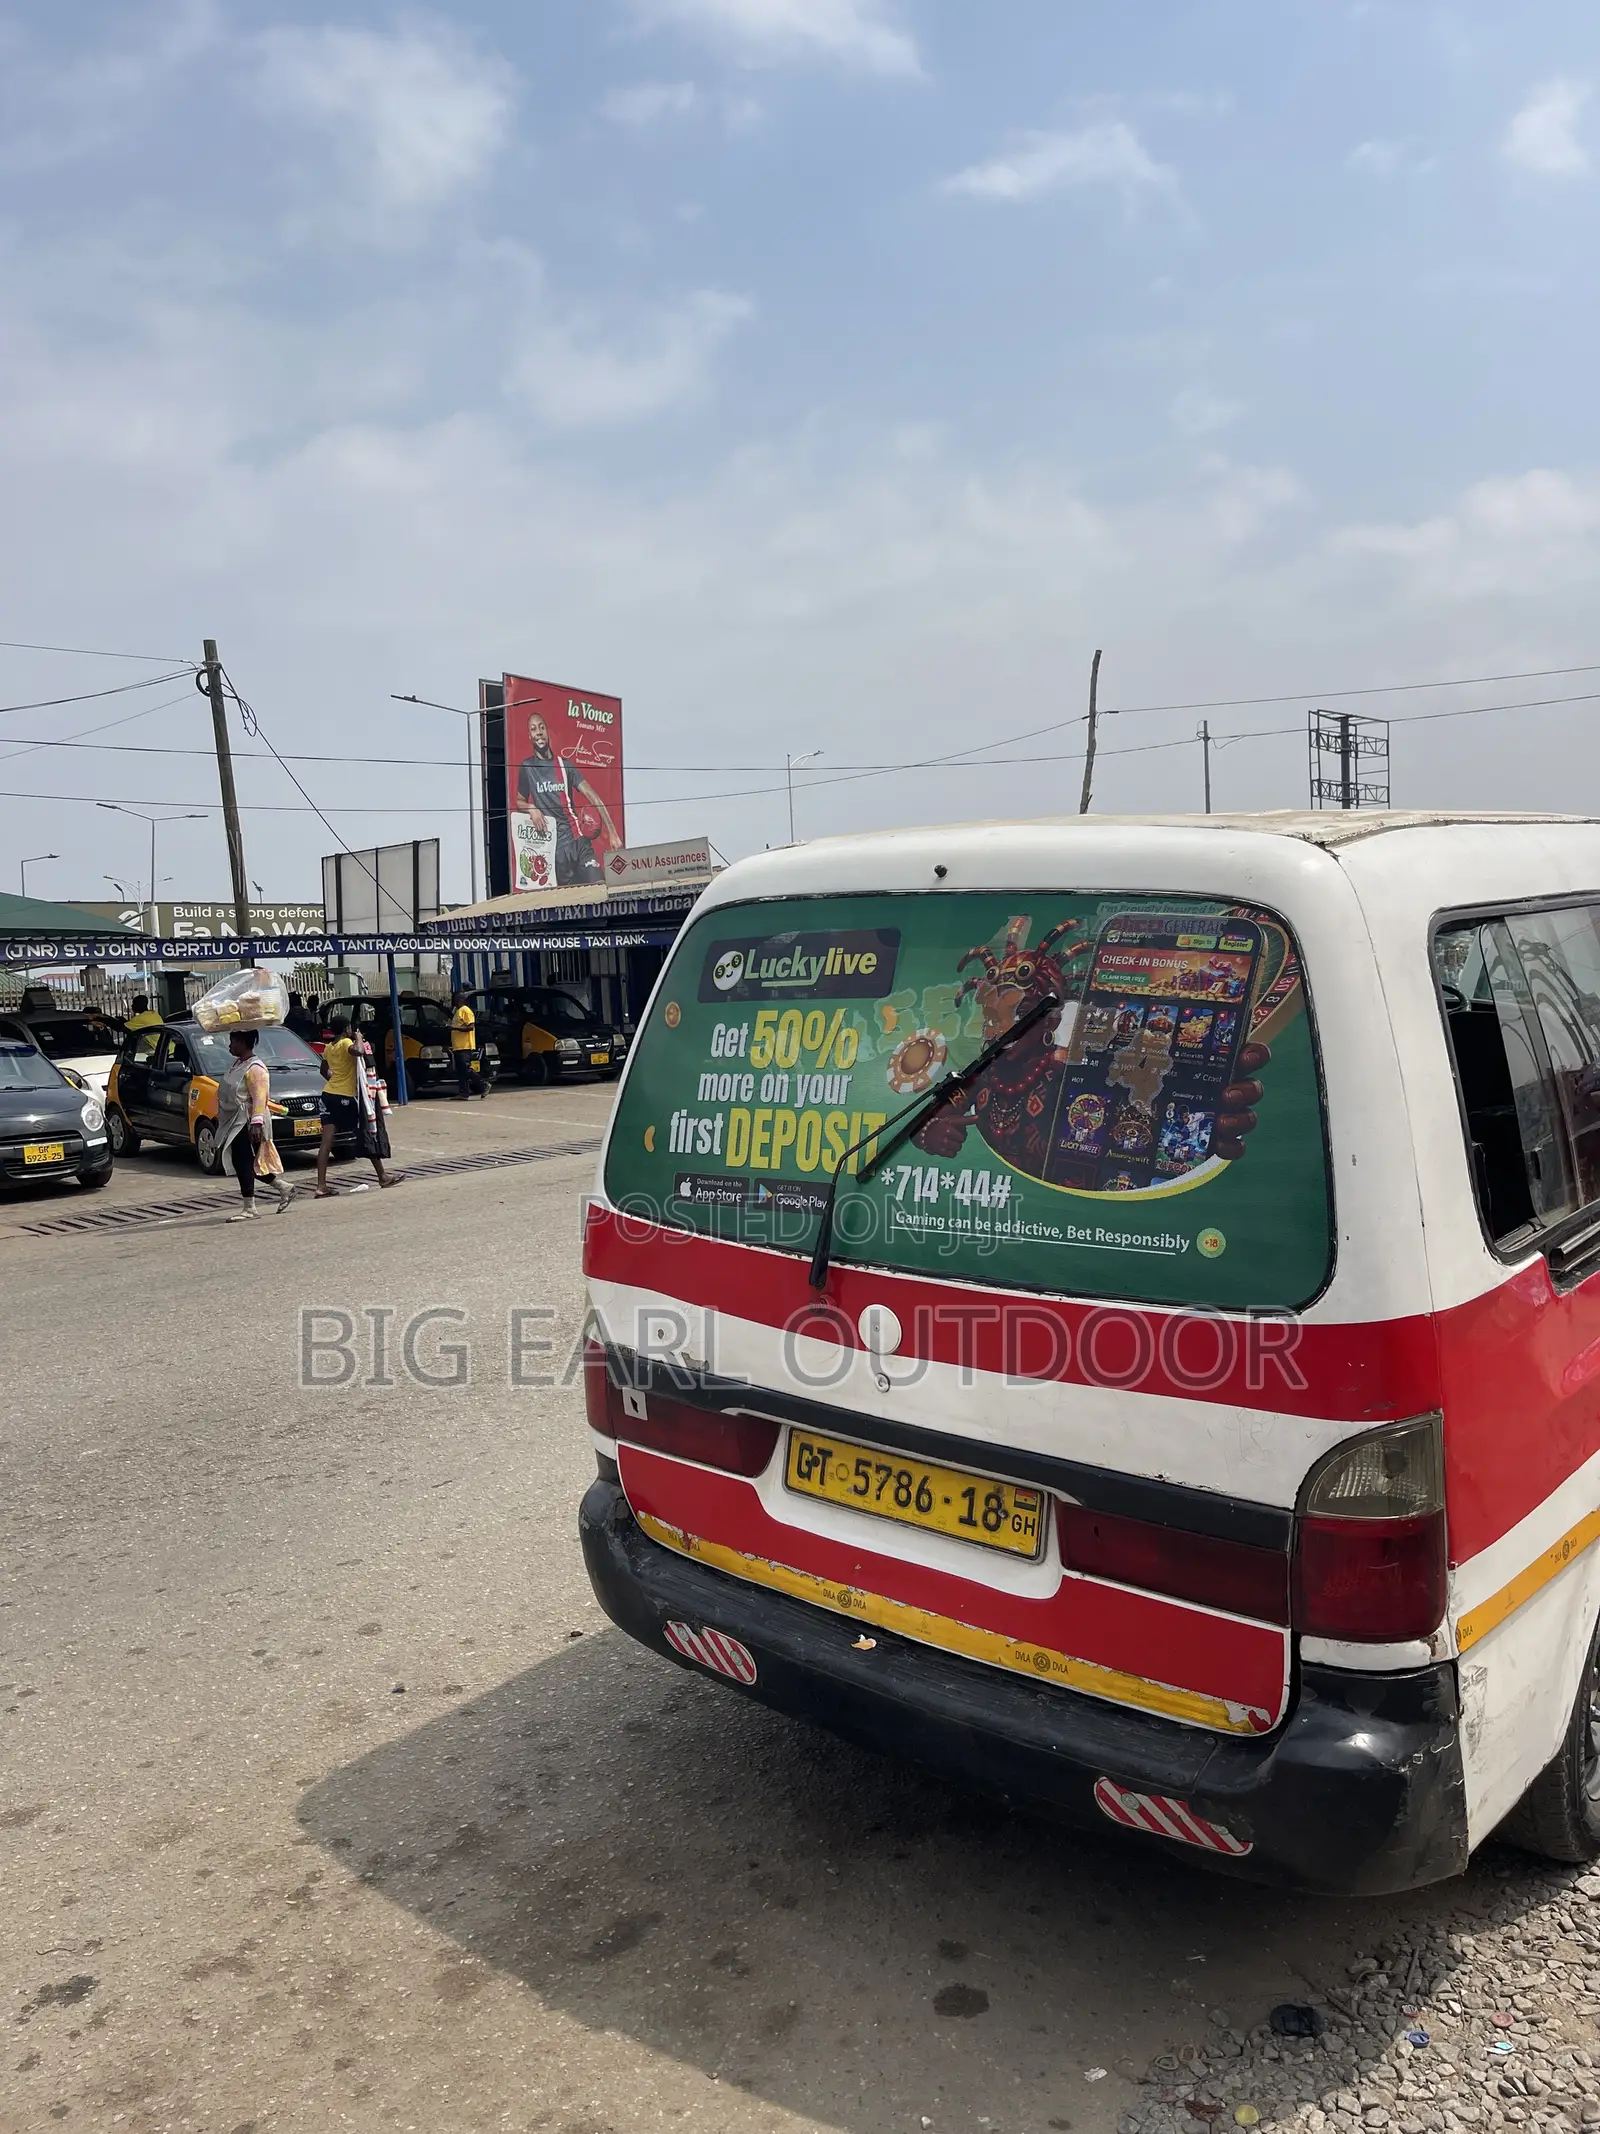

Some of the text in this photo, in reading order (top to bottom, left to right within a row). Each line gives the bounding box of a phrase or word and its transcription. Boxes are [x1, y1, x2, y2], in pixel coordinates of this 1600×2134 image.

[567, 698, 615, 725] la Vonce
[576, 720, 606, 732] Tomato Mix
[631, 852, 707, 870] SUNU Assurances
[173, 906, 212, 918] Build
[216, 909, 225, 918] a
[555, 905, 587, 920] TAXI
[592, 900, 638, 918] UNION
[5, 942, 59, 961] (JNR)
[64, 944, 90, 957] ST.
[94, 942, 157, 957] JOHN'S
[228, 942, 250, 954] OF
[286, 940, 334, 953] ACCRA
[543, 936, 581, 949] HOUSE
[585, 936, 611, 948] TAXI
[616, 934, 650, 946] RANK.
[1223, 940, 1249, 949] Register
[744, 944, 878, 988] Luckylive
[1102, 954, 1189, 970] CHECK-IN BONUS
[1102, 974, 1119, 982] CLAIM
[1132, 976, 1147, 984] FREE
[710, 1007, 860, 1070] Get 50%
[698, 1072, 854, 1109] more on your
[668, 1108, 888, 1177] first DEPOSIT
[1060, 1140, 1079, 1151] LUCKY
[696, 1178, 724, 1187] Download
[696, 1187, 742, 1203] App Store
[776, 1193, 828, 1210] Google Play
[896, 1210, 1190, 1253] Gaming can be addictive, Bet Responsibly
[796, 1442, 834, 1487] GT
[1011, 1513, 1036, 1537] GH
[822, 1588, 868, 1610] DVLA DVLA
[1462, 1625, 1474, 1639] DVLA
[1015, 1650, 1069, 1675] DVLA DVLA
